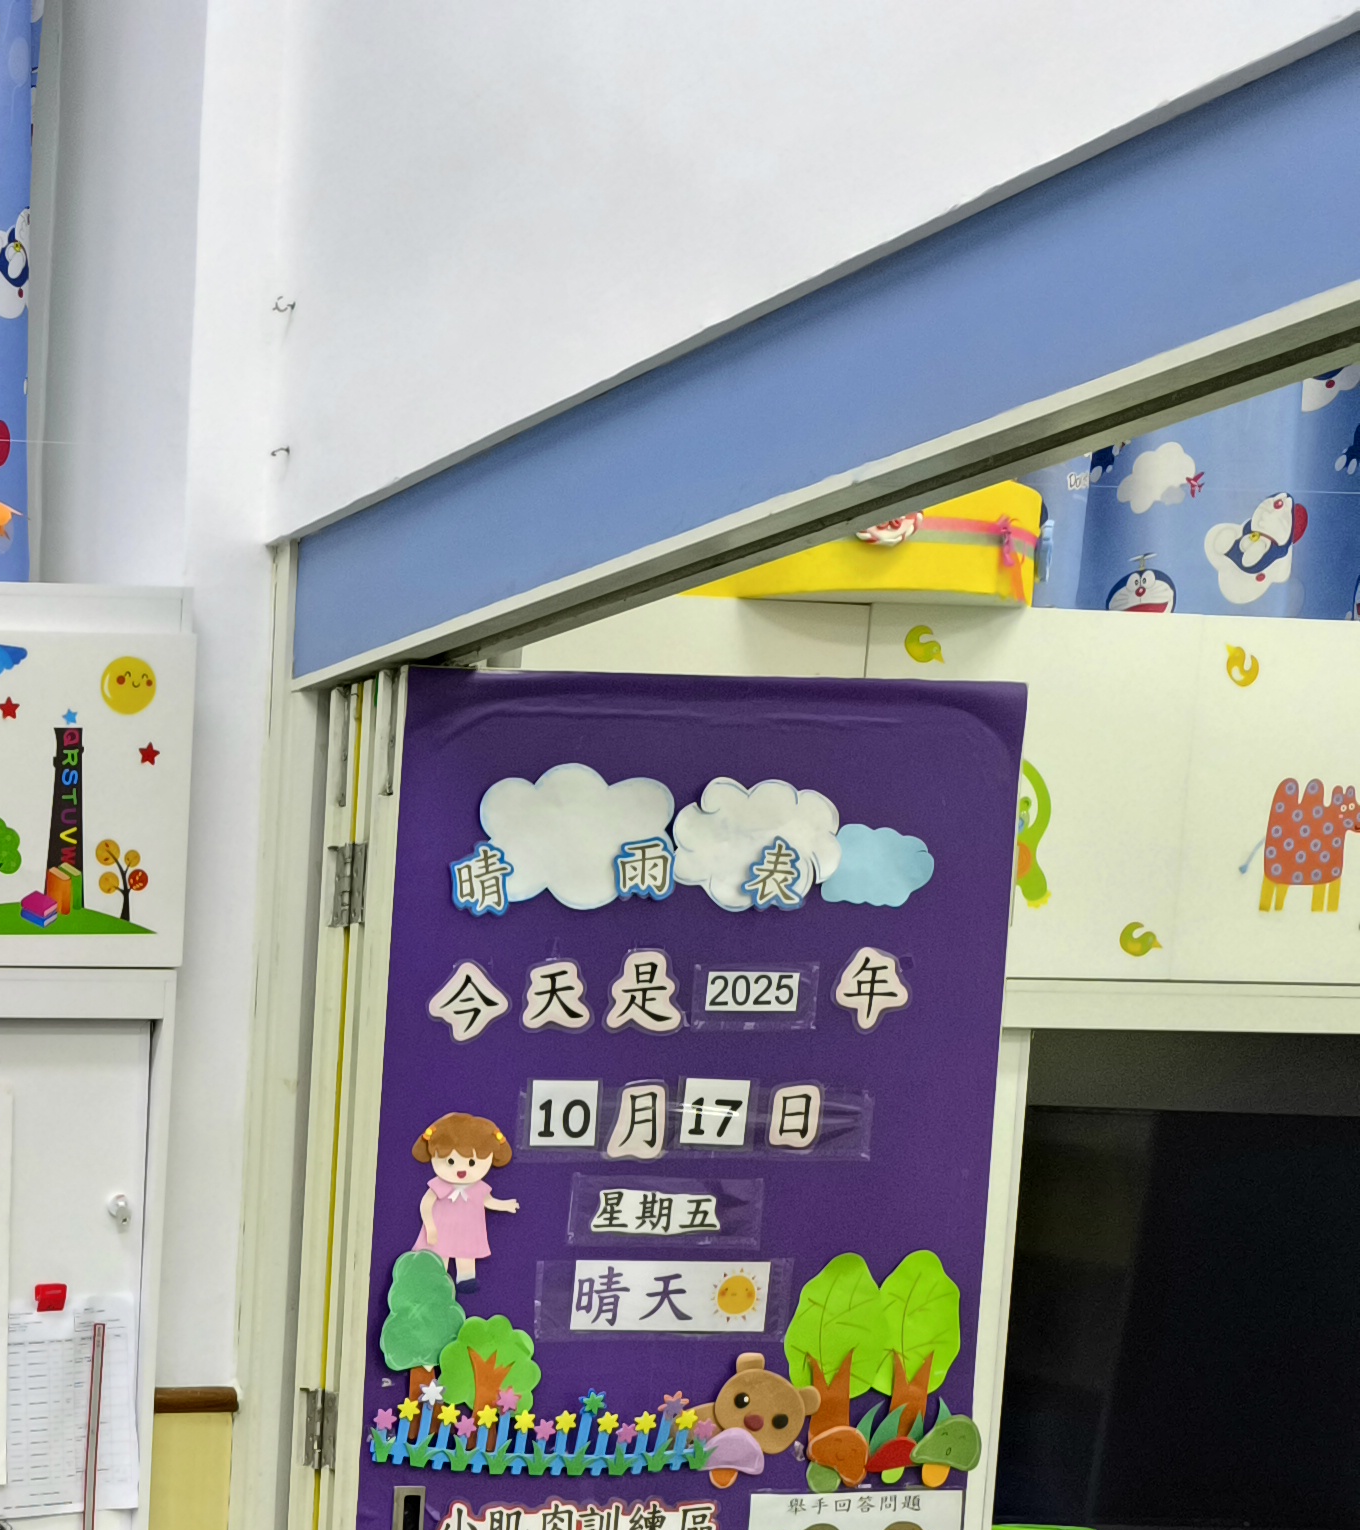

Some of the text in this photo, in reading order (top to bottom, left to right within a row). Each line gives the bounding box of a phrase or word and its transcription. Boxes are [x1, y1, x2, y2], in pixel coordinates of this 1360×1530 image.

[591, 1188, 720, 1232] 星期五
[575, 1266, 693, 1325] 晴天
[786, 1494, 922, 1515] 舉手回答問題
